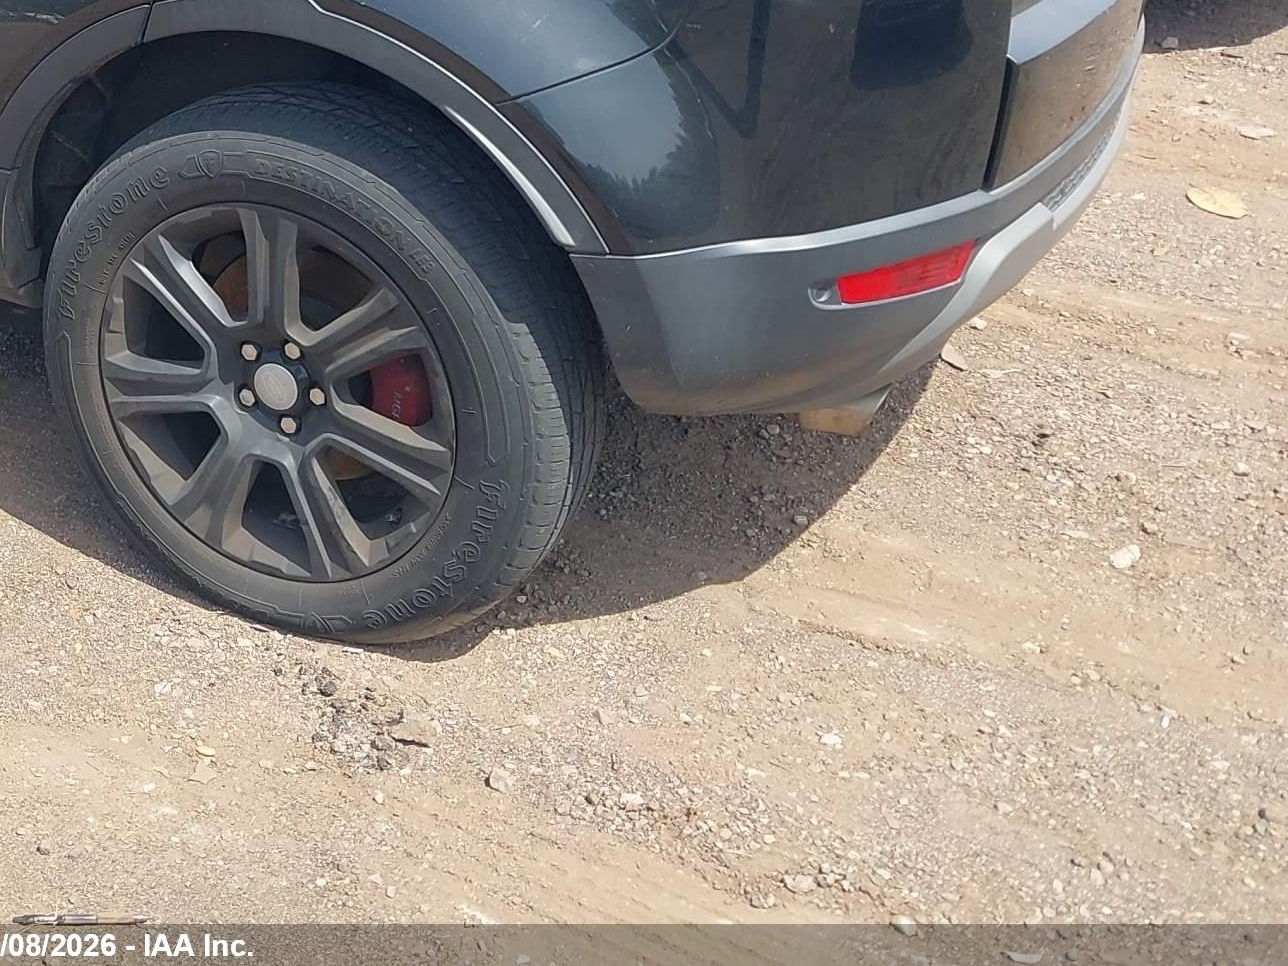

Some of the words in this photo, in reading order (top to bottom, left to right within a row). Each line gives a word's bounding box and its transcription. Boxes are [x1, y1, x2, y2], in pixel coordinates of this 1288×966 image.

[56, 164, 170, 322] Firestone
[254, 157, 411, 251] DESTINATION
[362, 479, 511, 630] Firestone
